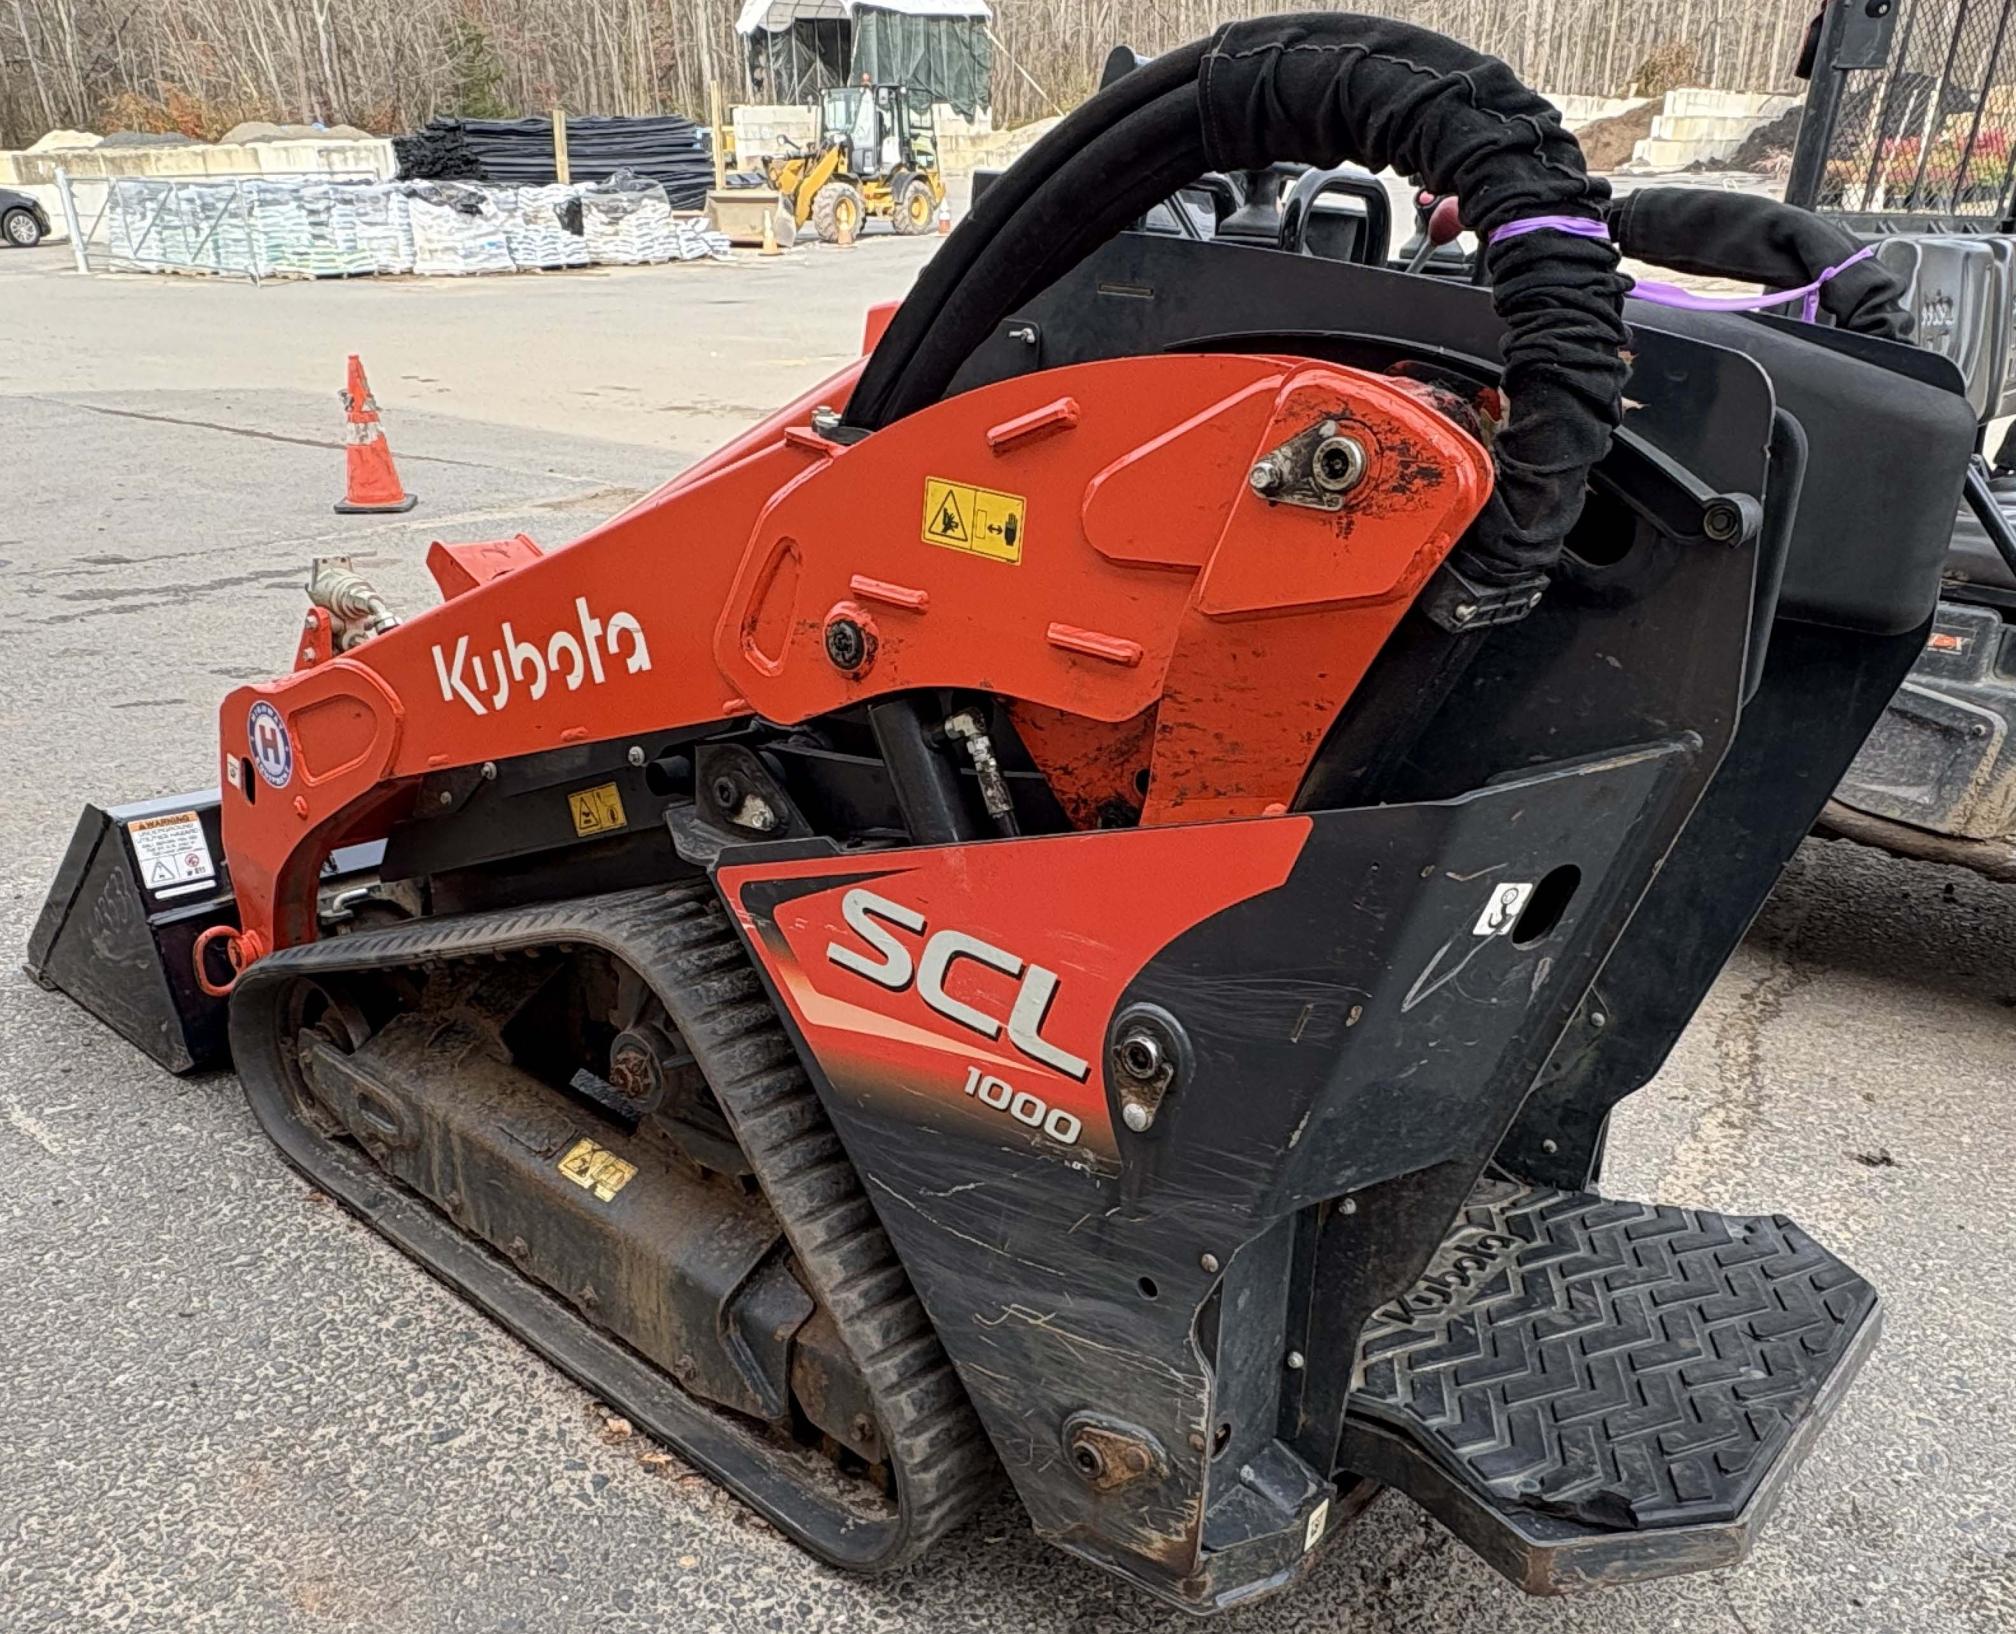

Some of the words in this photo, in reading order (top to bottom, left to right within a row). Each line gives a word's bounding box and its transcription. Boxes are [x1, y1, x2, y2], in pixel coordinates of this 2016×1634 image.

[431, 596, 652, 716] Kubota
[259, 724, 281, 766] H
[145, 814, 190, 828] WARNING
[826, 888, 1091, 1084] SCL
[964, 1065, 1083, 1145] 1000
[1381, 1234, 1517, 1325] Kubota
